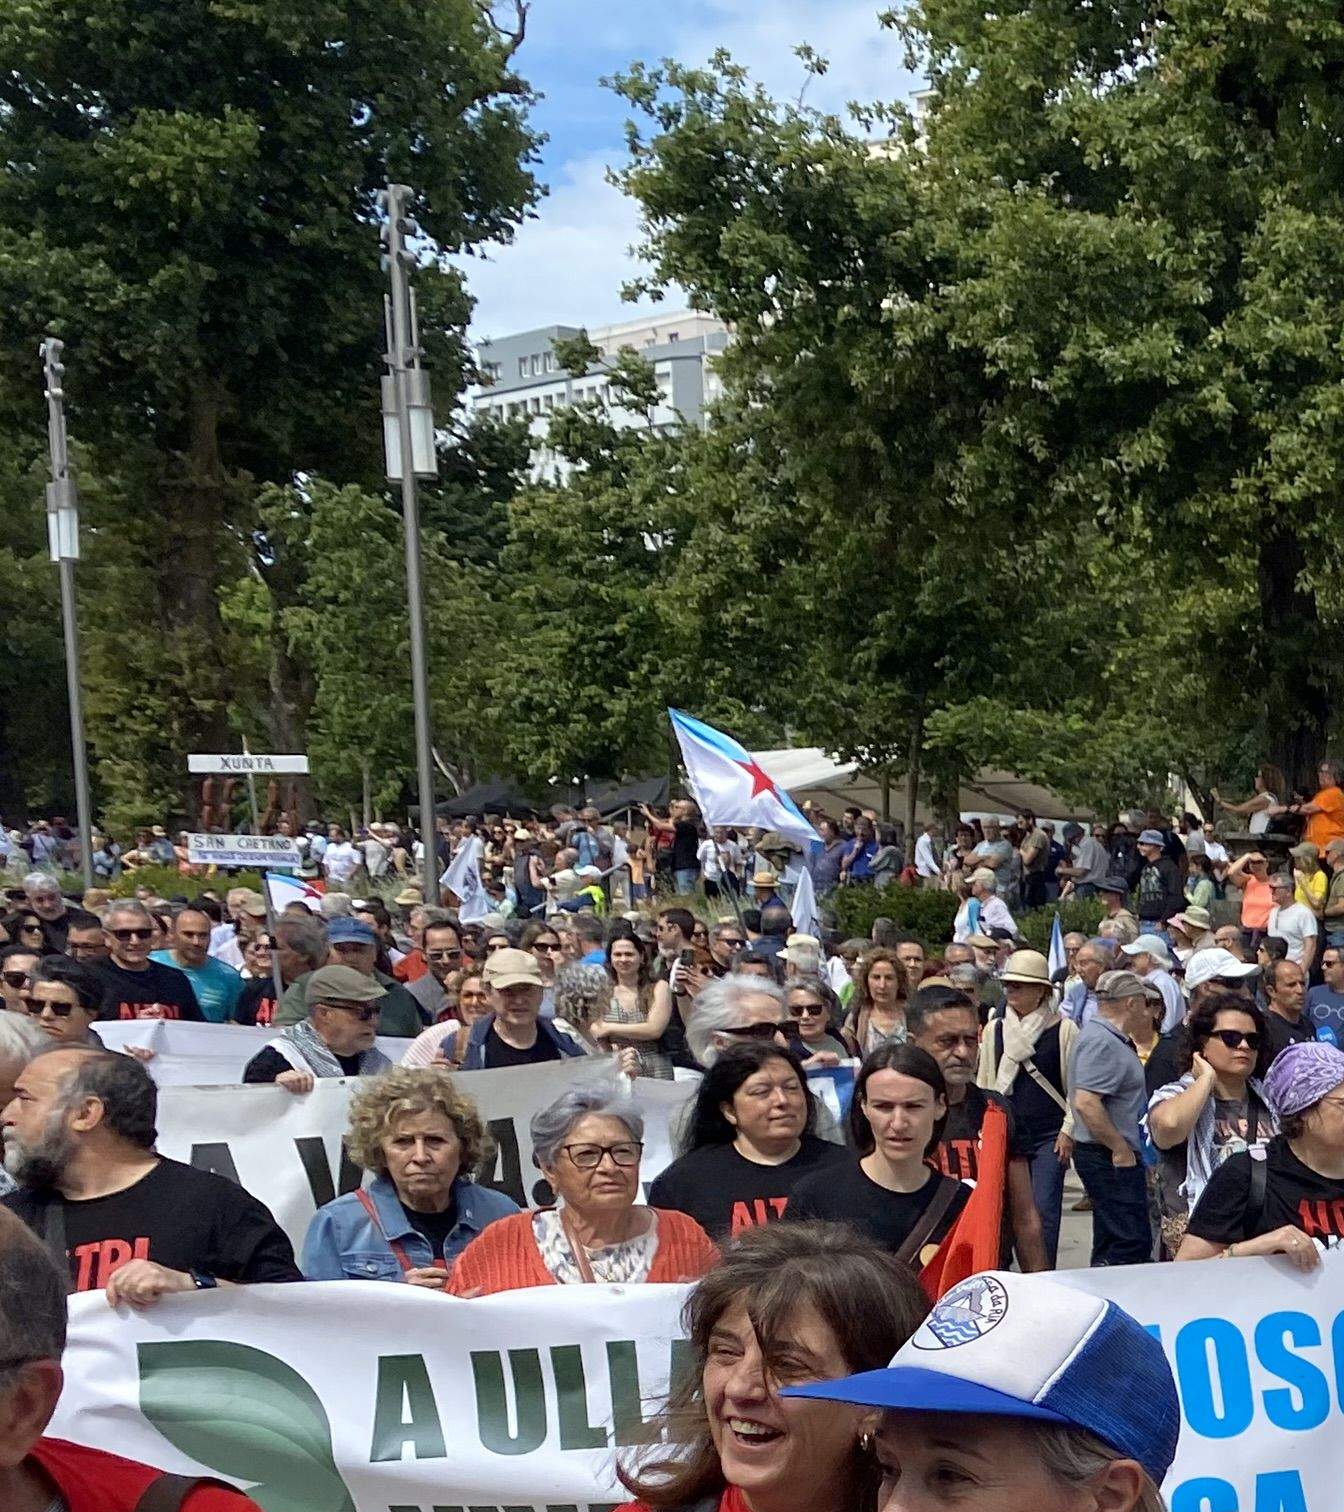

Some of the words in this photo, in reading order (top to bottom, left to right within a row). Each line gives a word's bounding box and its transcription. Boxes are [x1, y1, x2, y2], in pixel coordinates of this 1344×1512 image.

[219, 756, 275, 770] XUNTA
[194, 835, 226, 849] SAN
[369, 1353, 448, 1463] A
